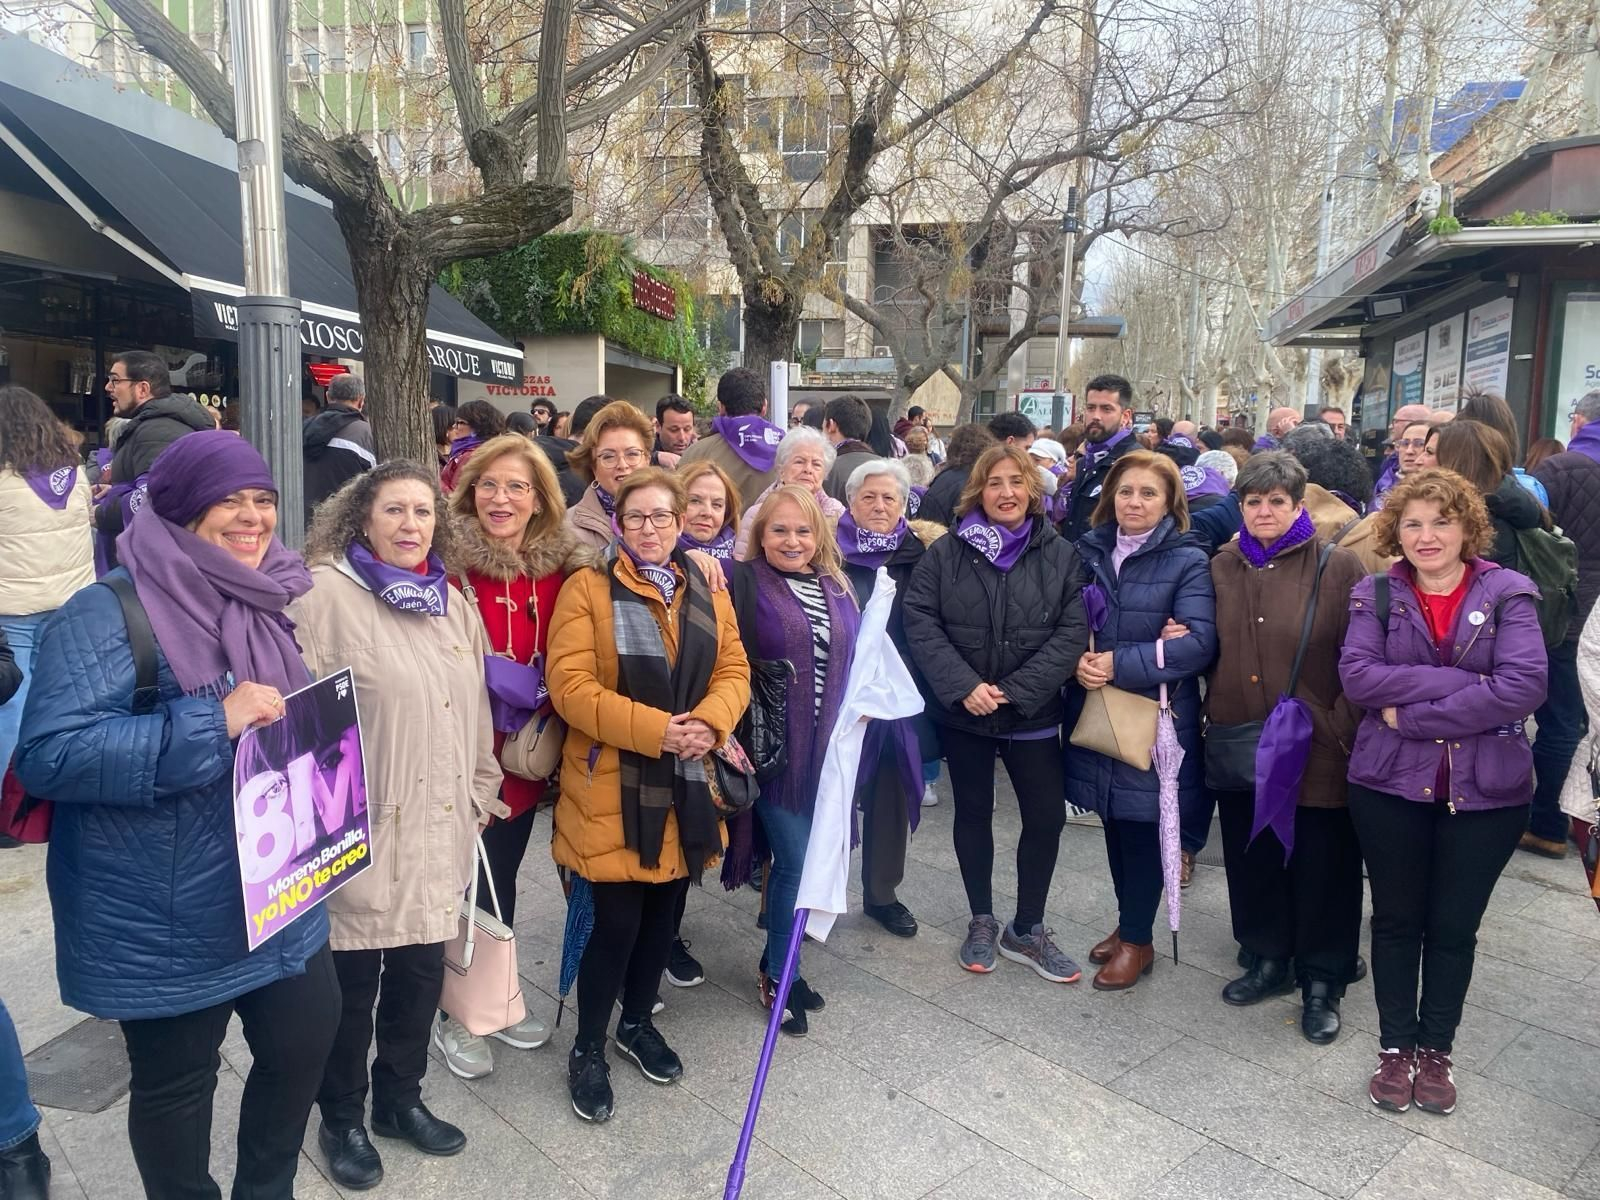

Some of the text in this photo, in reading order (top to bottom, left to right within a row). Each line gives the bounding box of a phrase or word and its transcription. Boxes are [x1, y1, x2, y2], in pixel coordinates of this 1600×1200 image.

[214, 302, 239, 326] VICT
[426, 344, 481, 376] ARQUE
[523, 375, 551, 384] EZAS
[486, 385, 557, 396] VICTORIA
[867, 537, 888, 547] PSOE
[711, 548, 730, 559] PSOE
[399, 600, 423, 610] Jaén
[236, 726, 367, 884] 8M
[267, 827, 366, 900] Moreno Bonilla,
[252, 842, 368, 938] yo NO te creo
